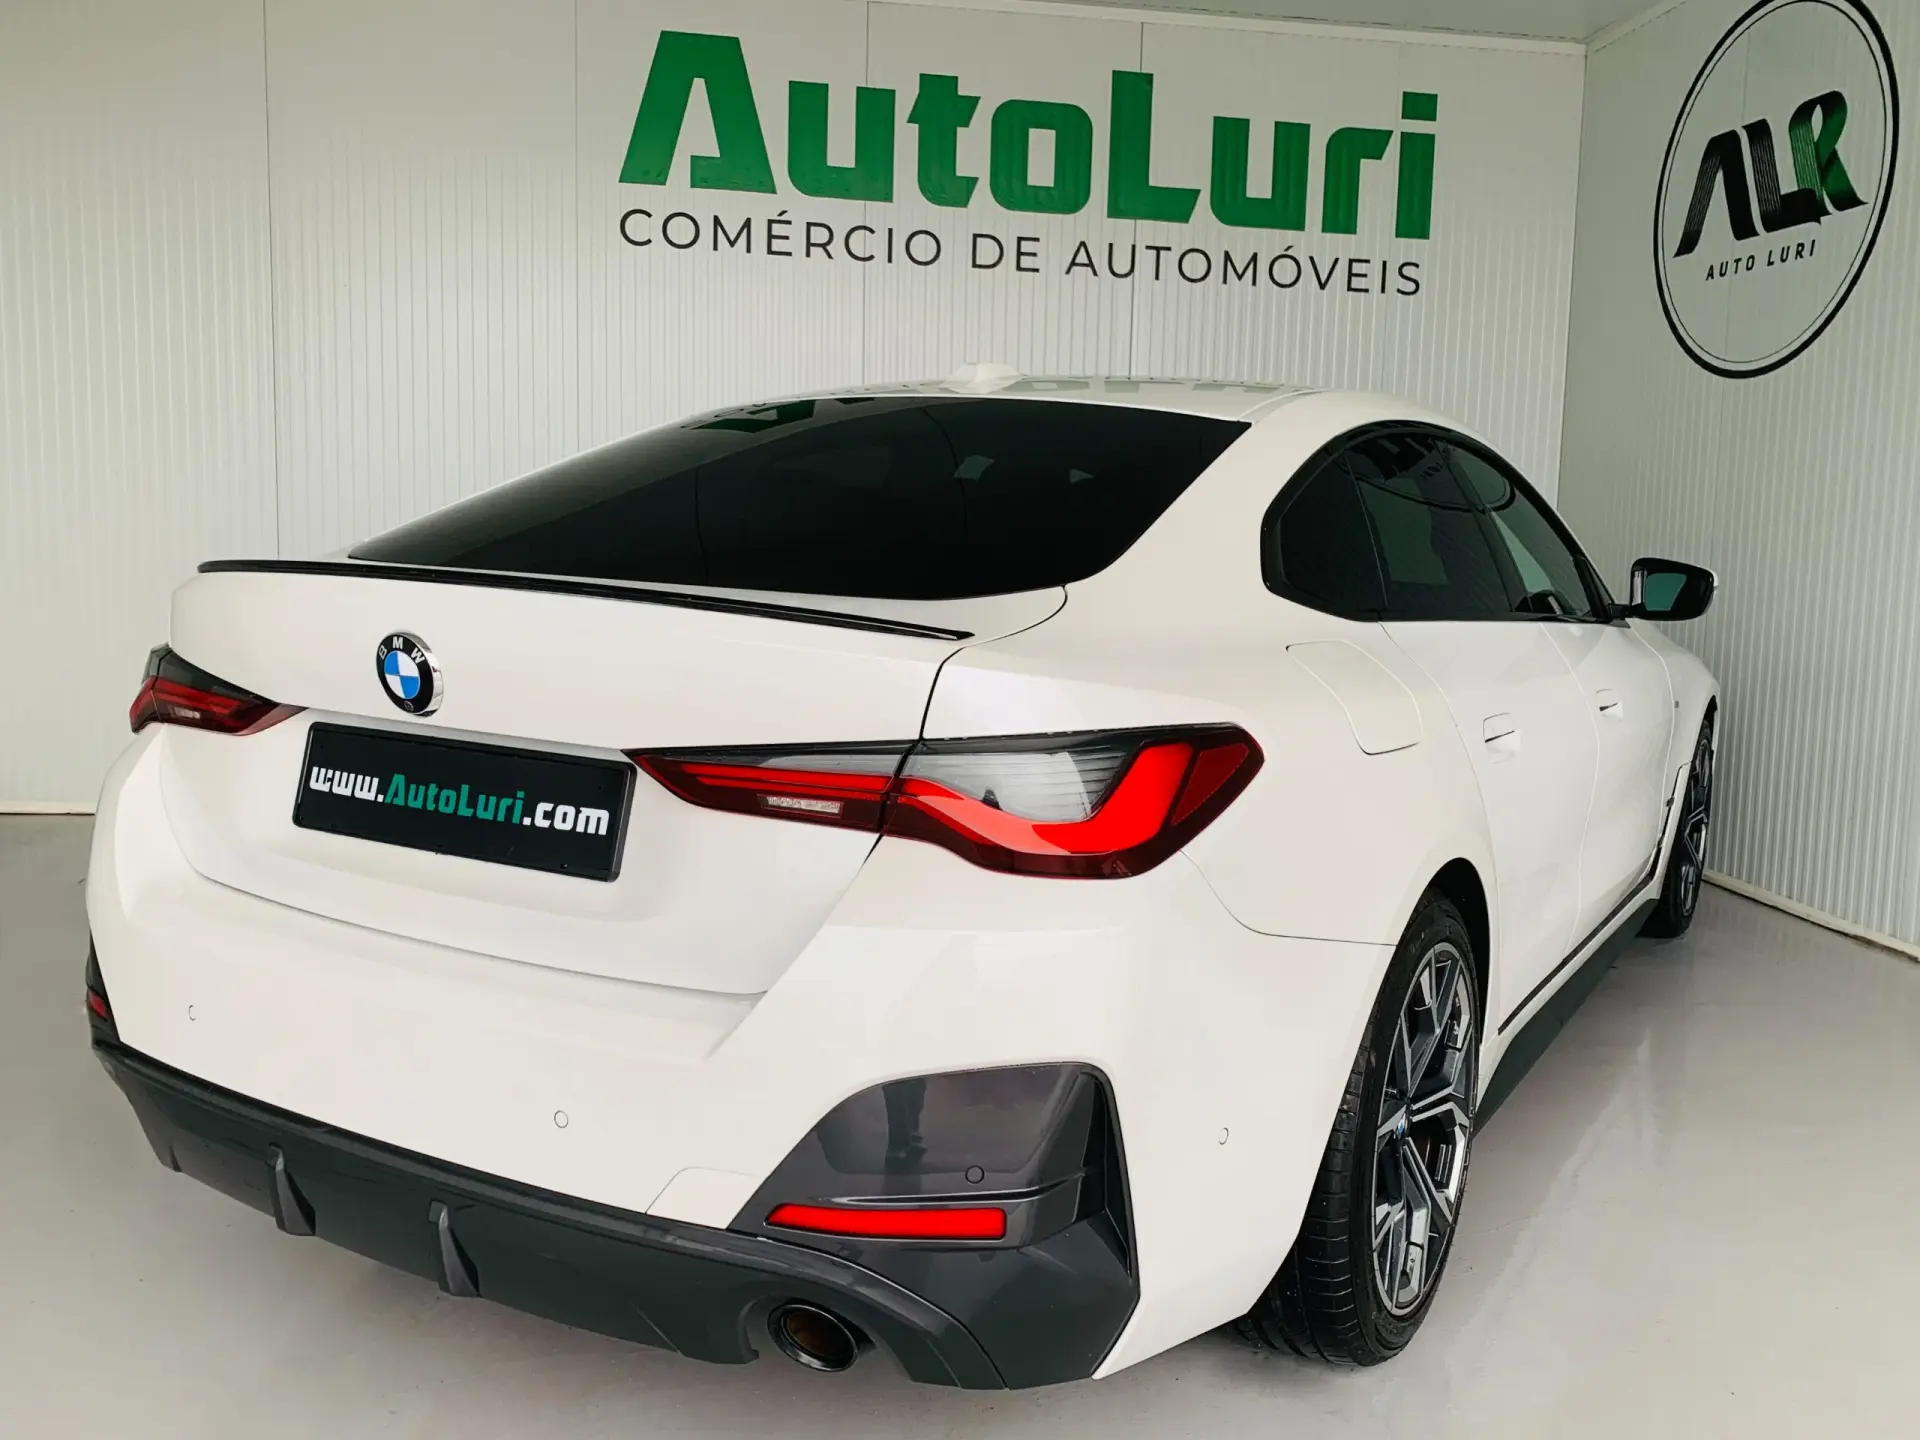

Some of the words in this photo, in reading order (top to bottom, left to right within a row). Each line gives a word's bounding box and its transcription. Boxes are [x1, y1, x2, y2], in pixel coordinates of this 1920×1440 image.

[619, 30, 1438, 240] AutoLuri
[620, 208, 942, 267] COMÉRCIO
[971, 233, 1041, 273] DE
[1065, 240, 1421, 296] AUTOMÓVEIS
[1705, 255, 1755, 281] AUTO
[1767, 239, 1815, 267] LURI
[379, 636, 425, 663] BMW
[309, 766, 610, 836] www.AutoLuri.com
